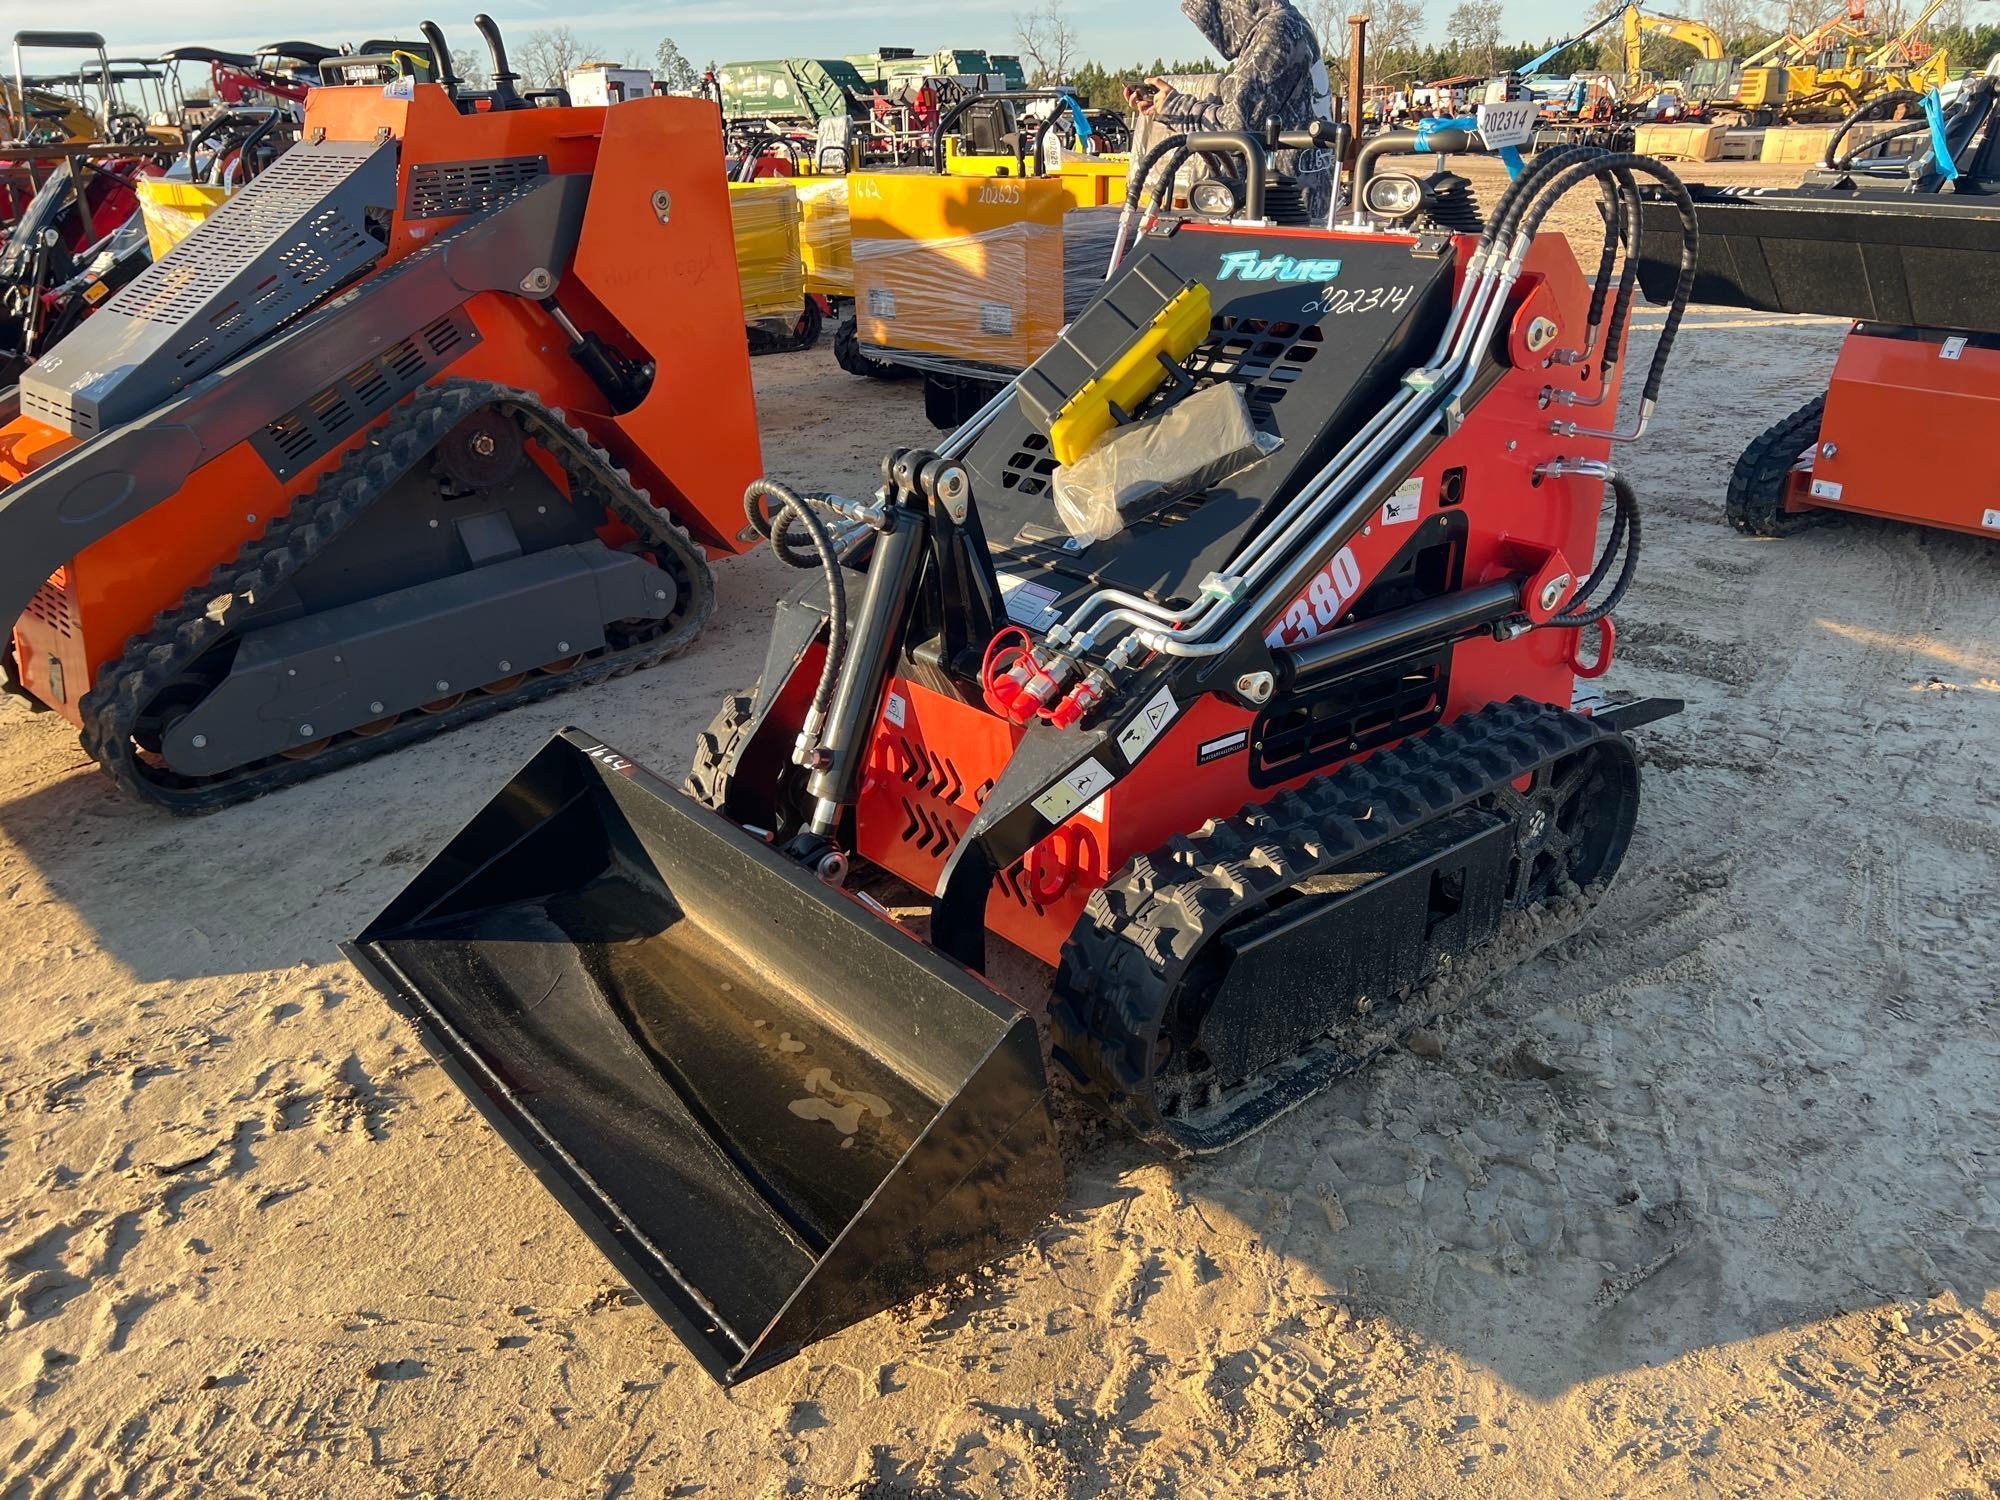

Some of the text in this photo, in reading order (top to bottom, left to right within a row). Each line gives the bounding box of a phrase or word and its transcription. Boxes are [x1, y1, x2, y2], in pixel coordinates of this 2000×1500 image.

[1484, 109, 1529, 133] 202314
[1049, 136, 1059, 166] 202625
[855, 180, 881, 200] 1662
[978, 184, 1021, 205] 202625
[1216, 249, 1343, 283] Future
[1301, 285, 1415, 315] 202314
[1265, 545, 1361, 649] T380
[581, 744, 632, 771] 1664
